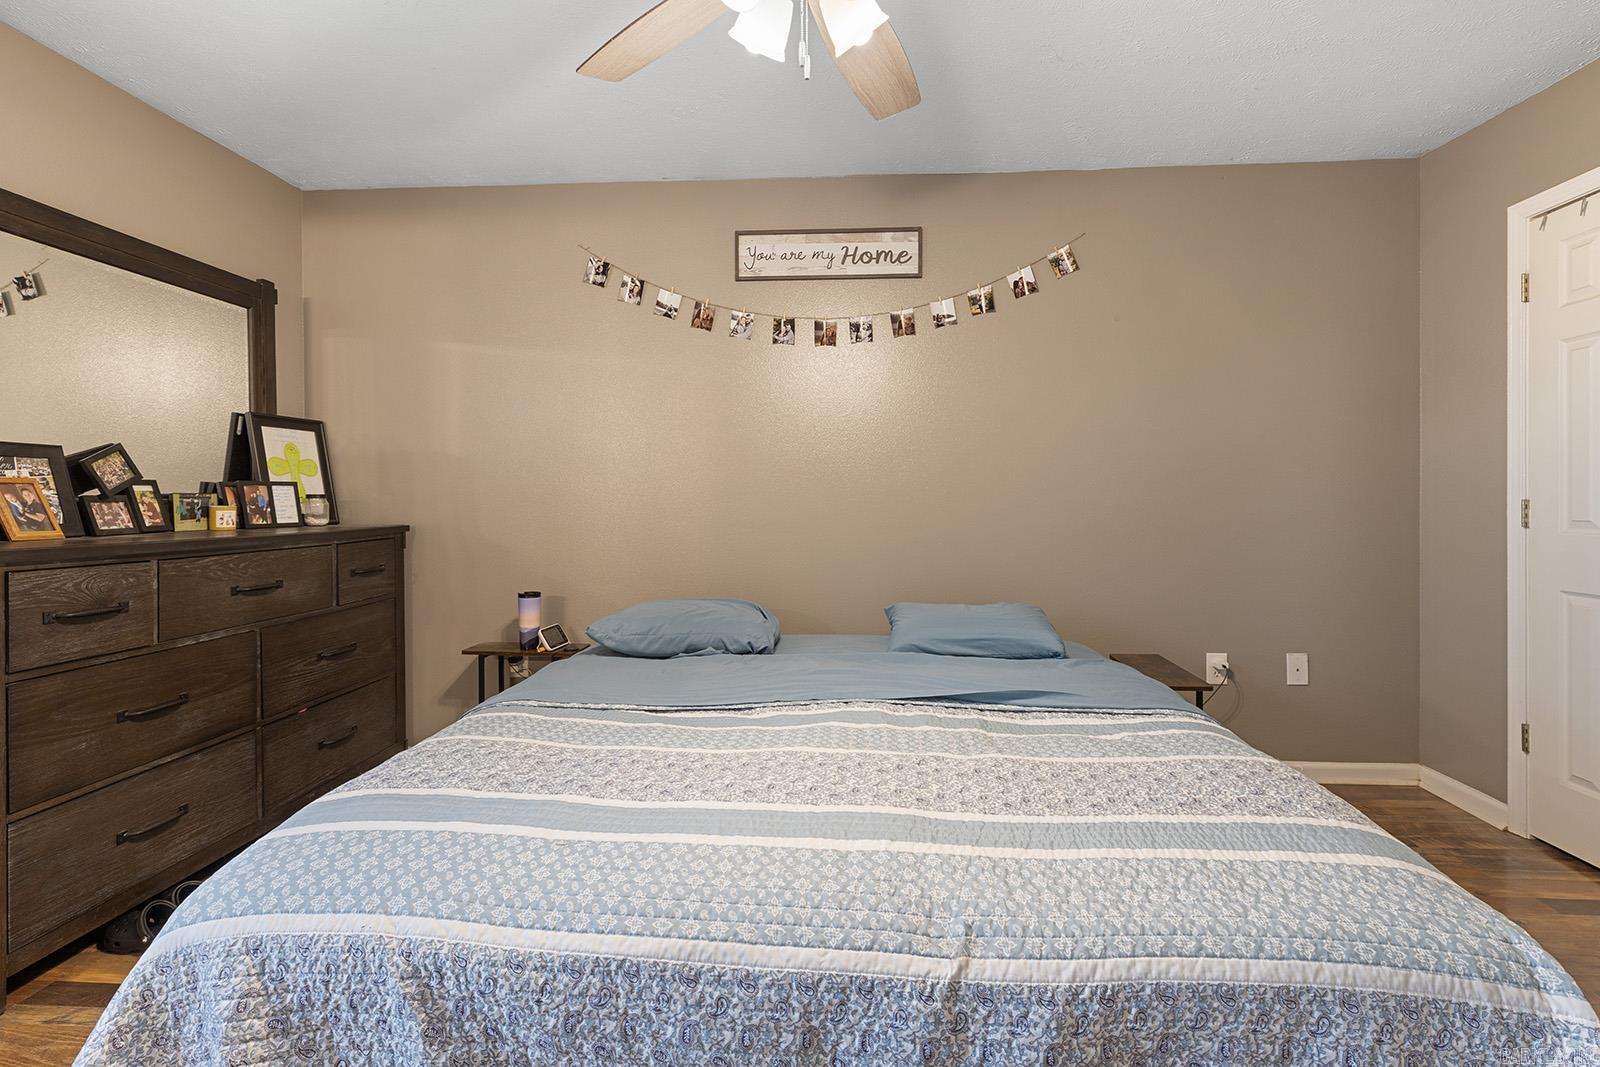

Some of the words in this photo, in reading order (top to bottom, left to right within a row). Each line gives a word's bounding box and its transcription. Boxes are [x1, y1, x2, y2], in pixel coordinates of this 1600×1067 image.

[743, 245, 776, 270] You
[780, 249, 807, 262] are
[811, 249, 836, 269] my
[840, 245, 913, 265] Home
